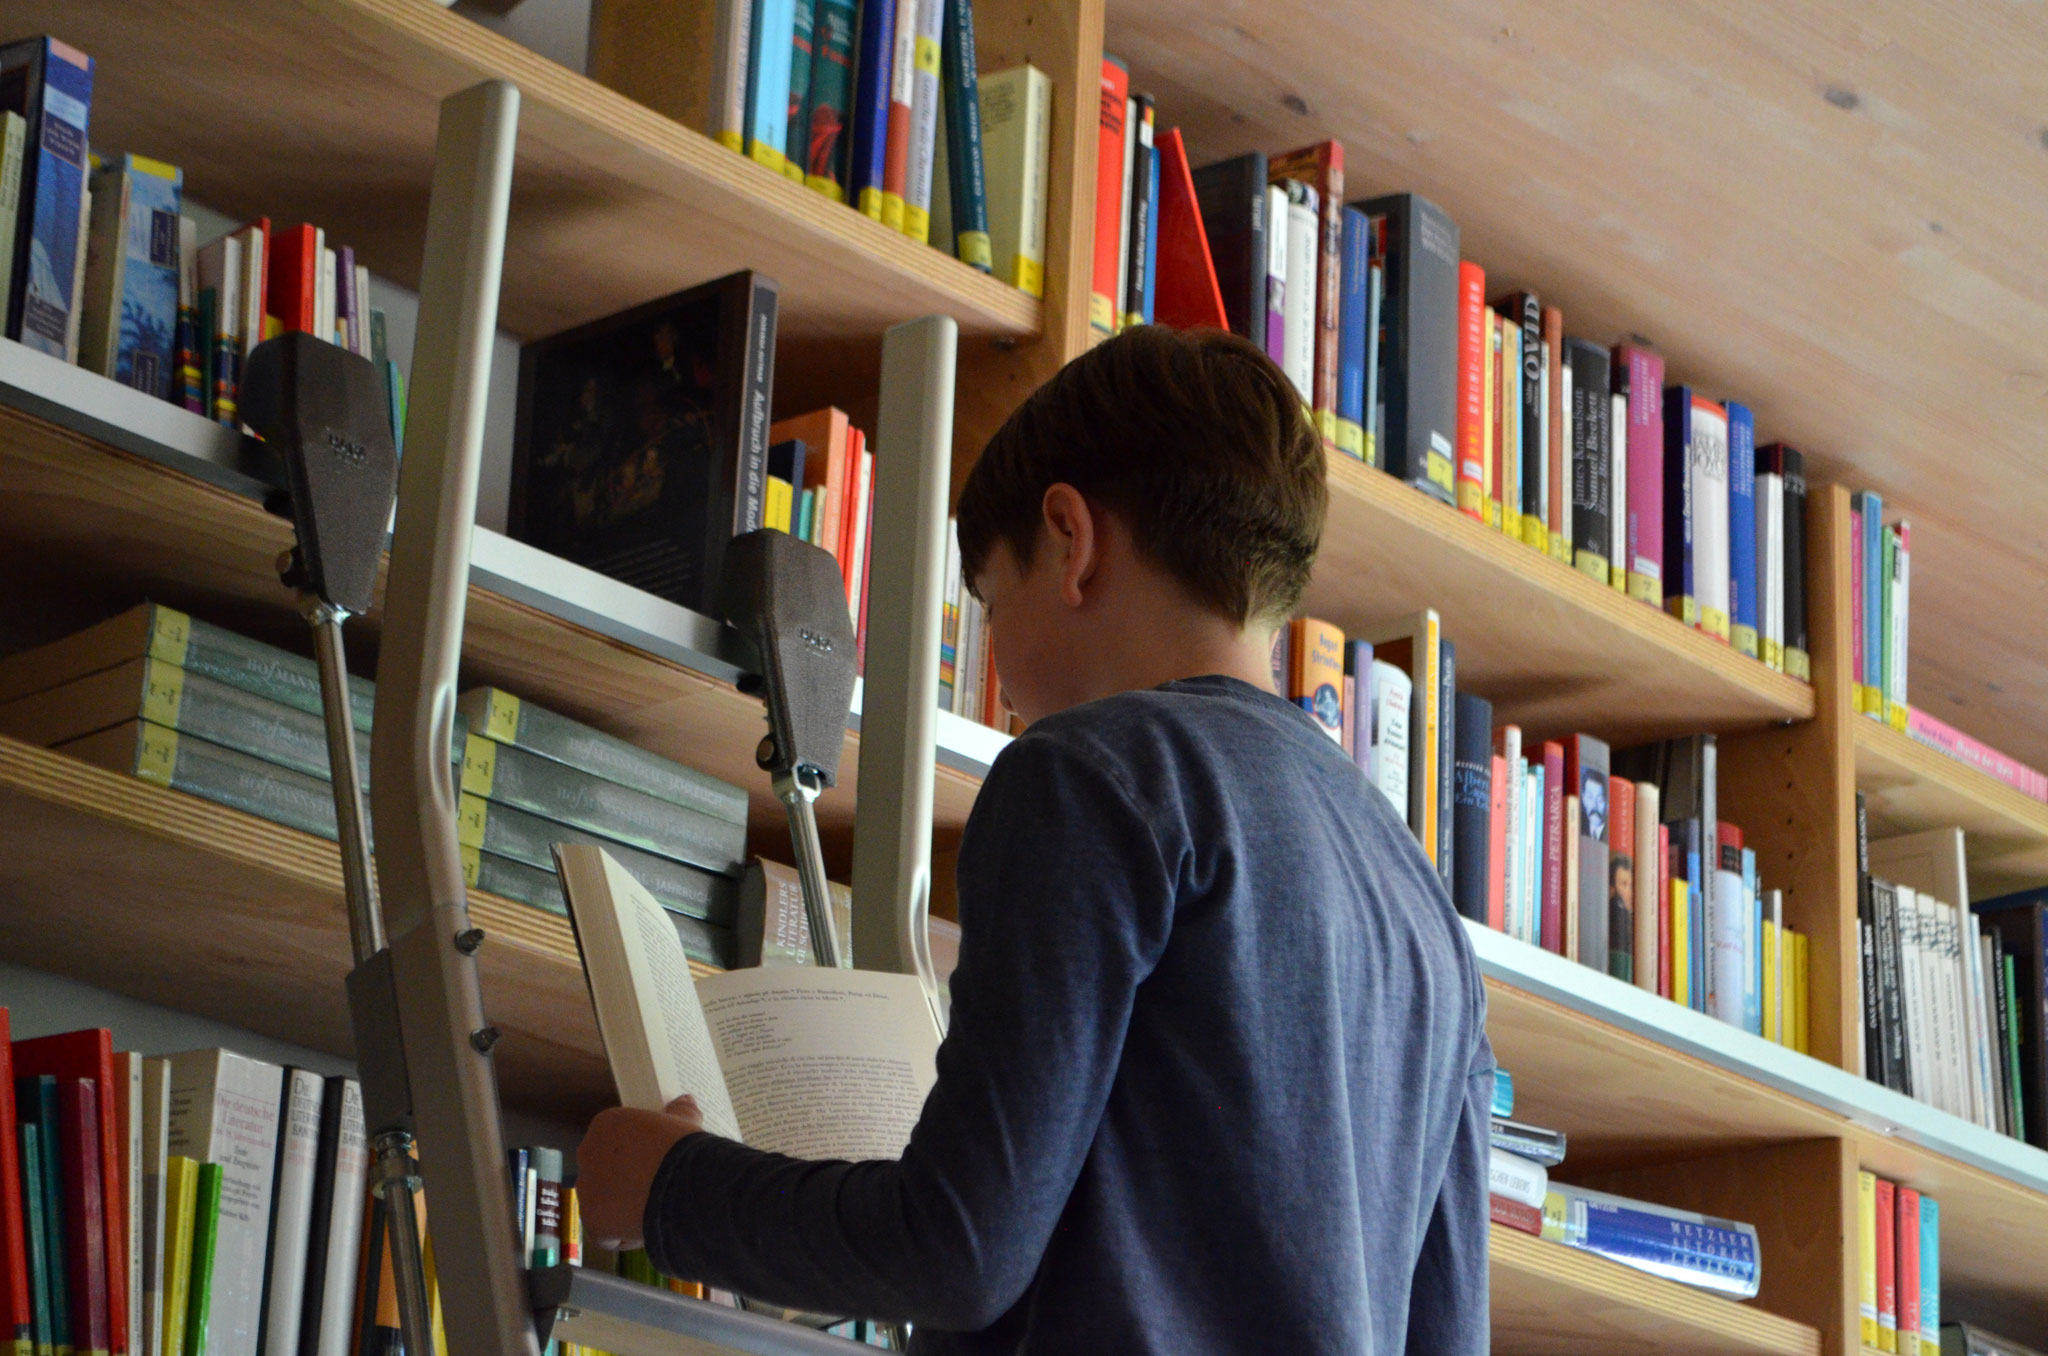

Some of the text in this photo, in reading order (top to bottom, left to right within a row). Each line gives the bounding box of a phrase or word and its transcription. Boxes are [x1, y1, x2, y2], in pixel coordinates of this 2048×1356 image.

[1523, 294, 1541, 381] OVID
[751, 390, 764, 454] Aufbruch
[1584, 390, 1598, 511] Samuel Beckett
[1598, 397, 1610, 517] Eine Biographie
[1572, 464, 1586, 506] James
[1443, 657, 1454, 688] Paris
[1956, 740, 1980, 763] Musik
[1549, 784, 1561, 906] STIERLE PETRARCA
[655, 877, 712, 903] JAHRBUCH
[775, 880, 789, 948] KINDLERS
[785, 882, 800, 956] LITERATUR
[1510, 1173, 1531, 1194] LEBENS
[1670, 1220, 1750, 1249] METZLER
[1672, 1236, 1751, 1262] AUTOREN
[1670, 1249, 1750, 1281] LEXIKON
